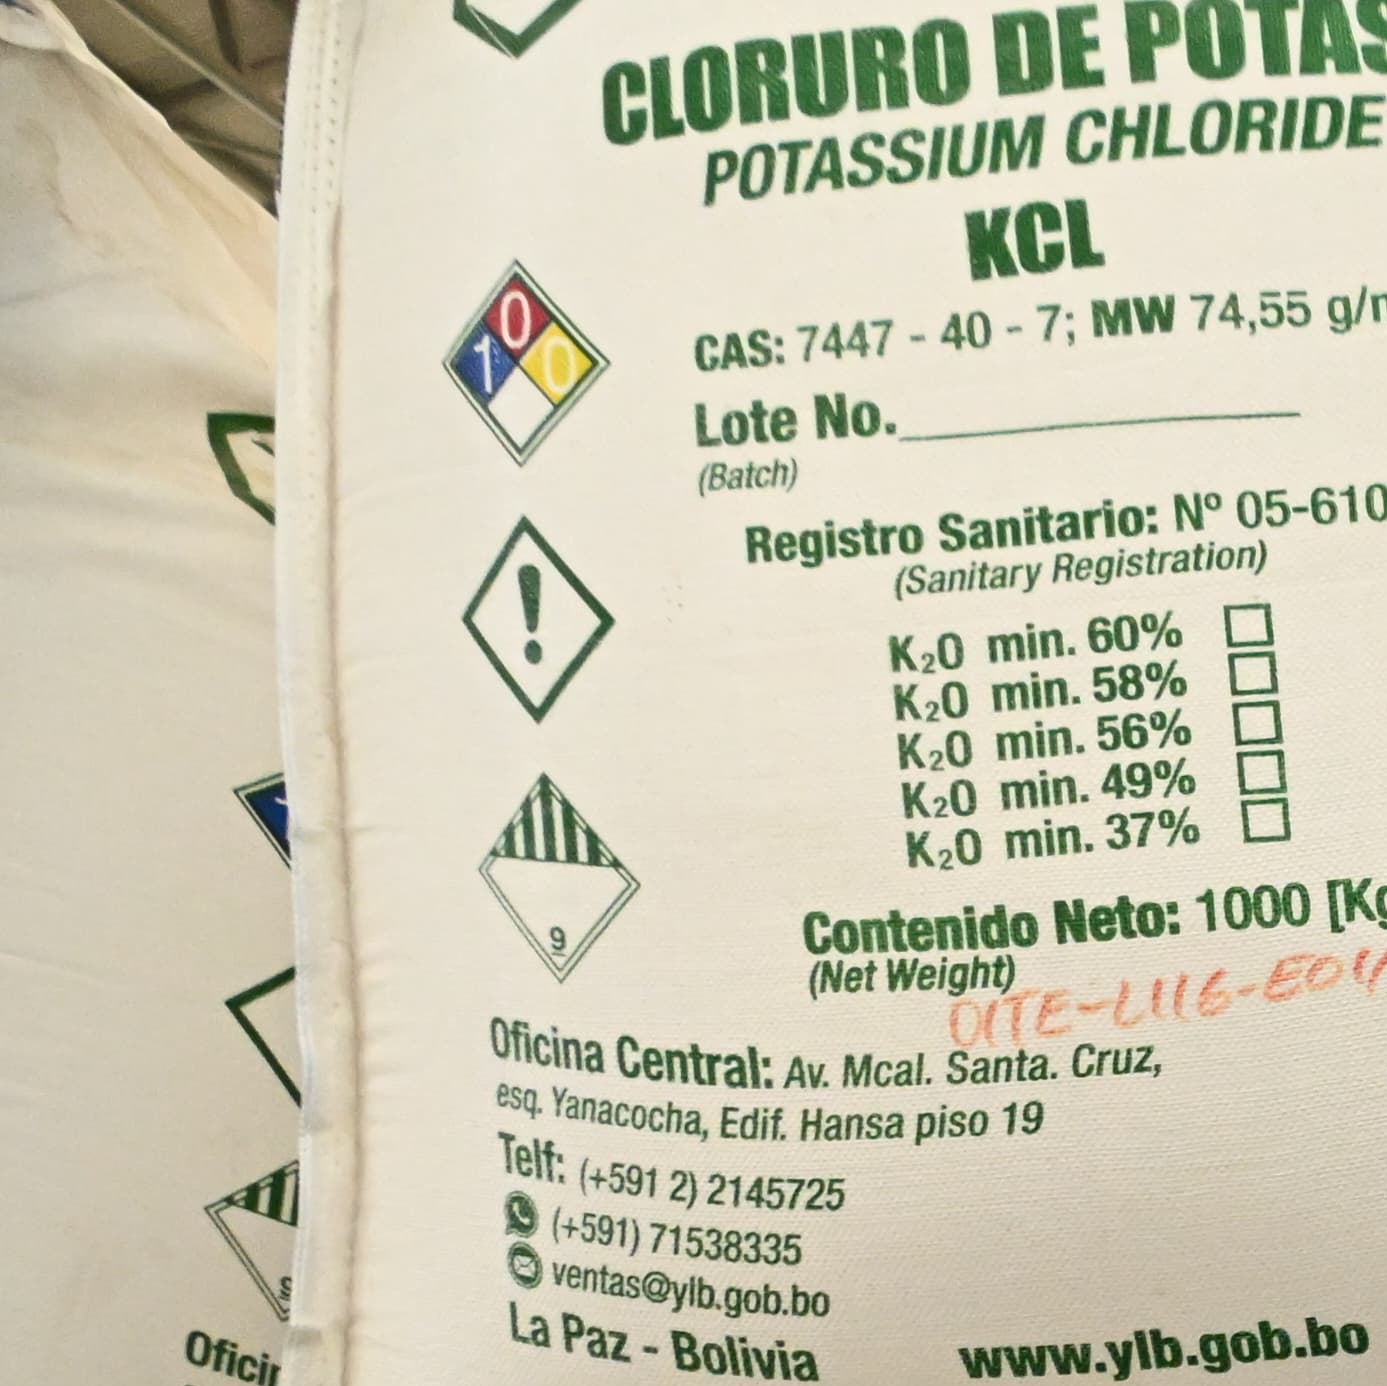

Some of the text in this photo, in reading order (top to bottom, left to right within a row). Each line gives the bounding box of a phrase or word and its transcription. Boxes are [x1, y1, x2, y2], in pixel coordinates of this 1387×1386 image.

[602, 19, 970, 145] CLORURO
[992, 4, 1105, 96] DE
[704, 95, 1386, 206] POTASSIUM CHLORIDE
[965, 199, 1105, 281] KCL
[499, 290, 531, 349] 0
[695, 329, 784, 371] CAS:
[798, 320, 893, 362] 7447
[941, 311, 991, 350] 40
[1037, 304, 1074, 346] 7;
[1091, 295, 1175, 337] MW
[1190, 291, 1311, 334] 74,55
[695, 391, 899, 447] Lote No.
[699, 458, 797, 496] (Batch)
[746, 519, 923, 568] Registro
[939, 499, 1158, 554] Sanitario:
[895, 540, 1267, 601] (Sanitary Registration)
[988, 623, 1075, 663] min.
[1088, 611, 1183, 653] 60%
[992, 672, 1080, 712] min.
[1093, 659, 1187, 703] 58%
[996, 721, 1085, 760] min.
[1097, 708, 1192, 751] 56%
[1001, 770, 1089, 810] min.
[1101, 757, 1196, 799] 49%
[1005, 819, 1093, 859] min.
[1106, 807, 1200, 850] 37%
[803, 904, 1039, 955] Contenido
[1053, 895, 1180, 944] Neto:
[1196, 882, 1311, 932] 1000
[809, 954, 1015, 1000] (Net Weight)
[491, 1017, 1161, 1089] Oficina Central: Av. Mcal. Santa. Cruz,
[497, 1084, 1044, 1146] esq. Yanacocha, Edif. Hansa piso 19
[498, 1132, 845, 1211] Telf: (+591 2) 2145725
[553, 1207, 802, 1265] (+591) 71538335
[553, 1263, 830, 1318] ventas@ylb.gob.bo
[510, 1301, 550, 1348] La
[562, 1312, 631, 1363] Paz
[671, 1330, 819, 1382] Bolivia
[958, 1317, 1369, 1381] www.ylb.gob.bo
